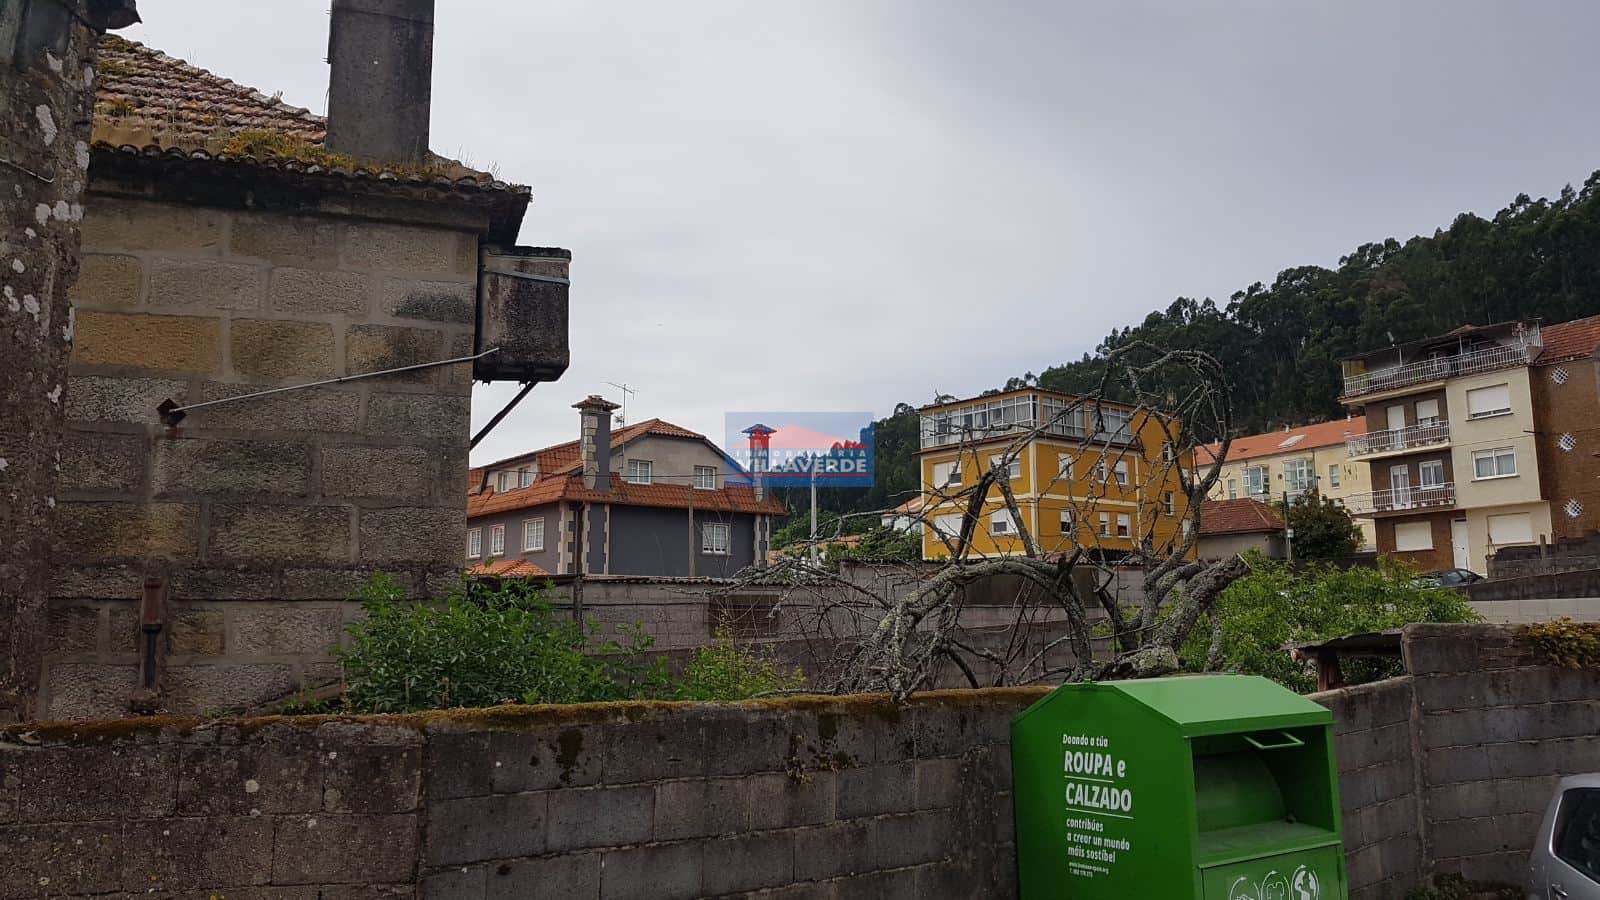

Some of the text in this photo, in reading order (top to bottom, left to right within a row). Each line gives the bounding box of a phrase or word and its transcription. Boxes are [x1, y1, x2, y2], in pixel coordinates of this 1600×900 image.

[1062, 734, 1108, 748] Doando a túa
[1064, 750, 1126, 778] ROUPA e
[1065, 782, 1132, 812] CALZADO
[1066, 818, 1104, 832] contribúes
[1067, 833, 1130, 851] a crear un mundo
[1068, 845, 1085, 858] máis
